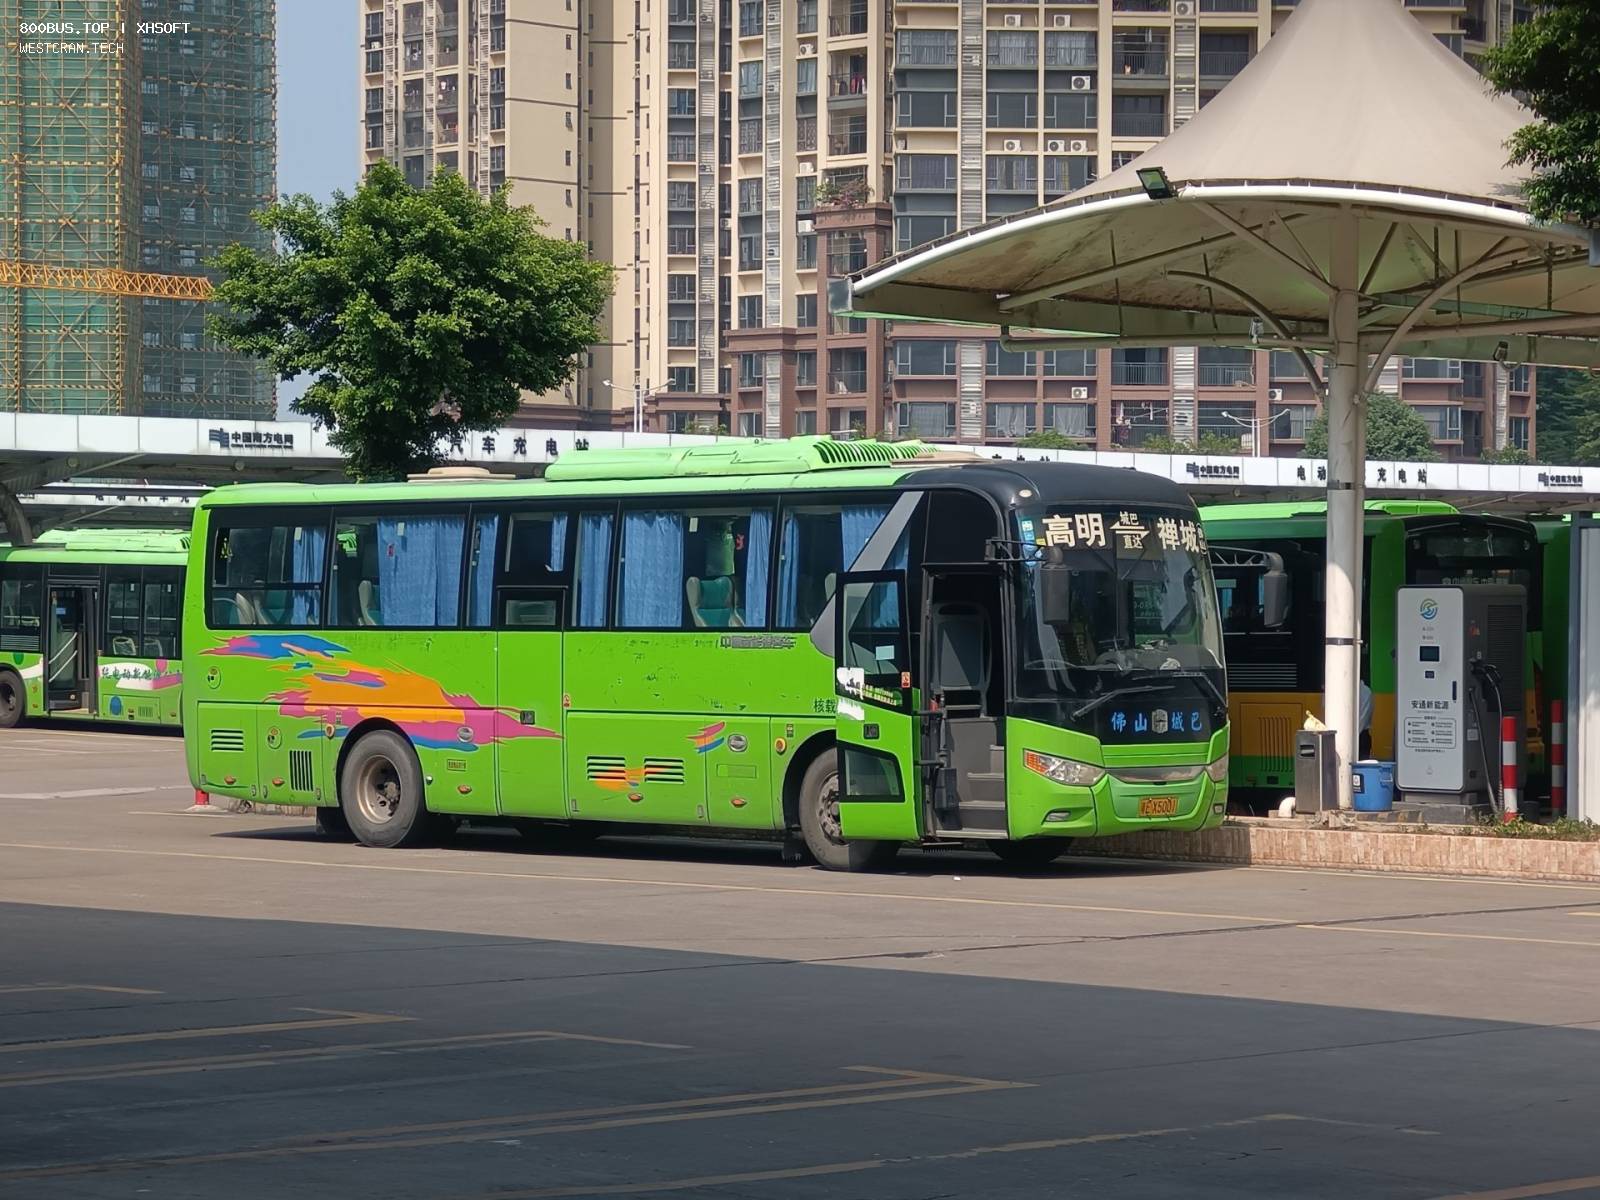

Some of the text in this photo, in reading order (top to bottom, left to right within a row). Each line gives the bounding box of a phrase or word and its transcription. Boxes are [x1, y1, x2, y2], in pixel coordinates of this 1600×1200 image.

[231, 431, 294, 444] 中国南方电网
[1296, 465, 1427, 484] 电动充电站
[1119, 511, 1139, 525] 城巴
[1042, 513, 1106, 548] 高明
[1157, 517, 1200, 553] 禅城
[1123, 534, 1144, 549] 直达
[1110, 712, 1148, 733] 佛山
